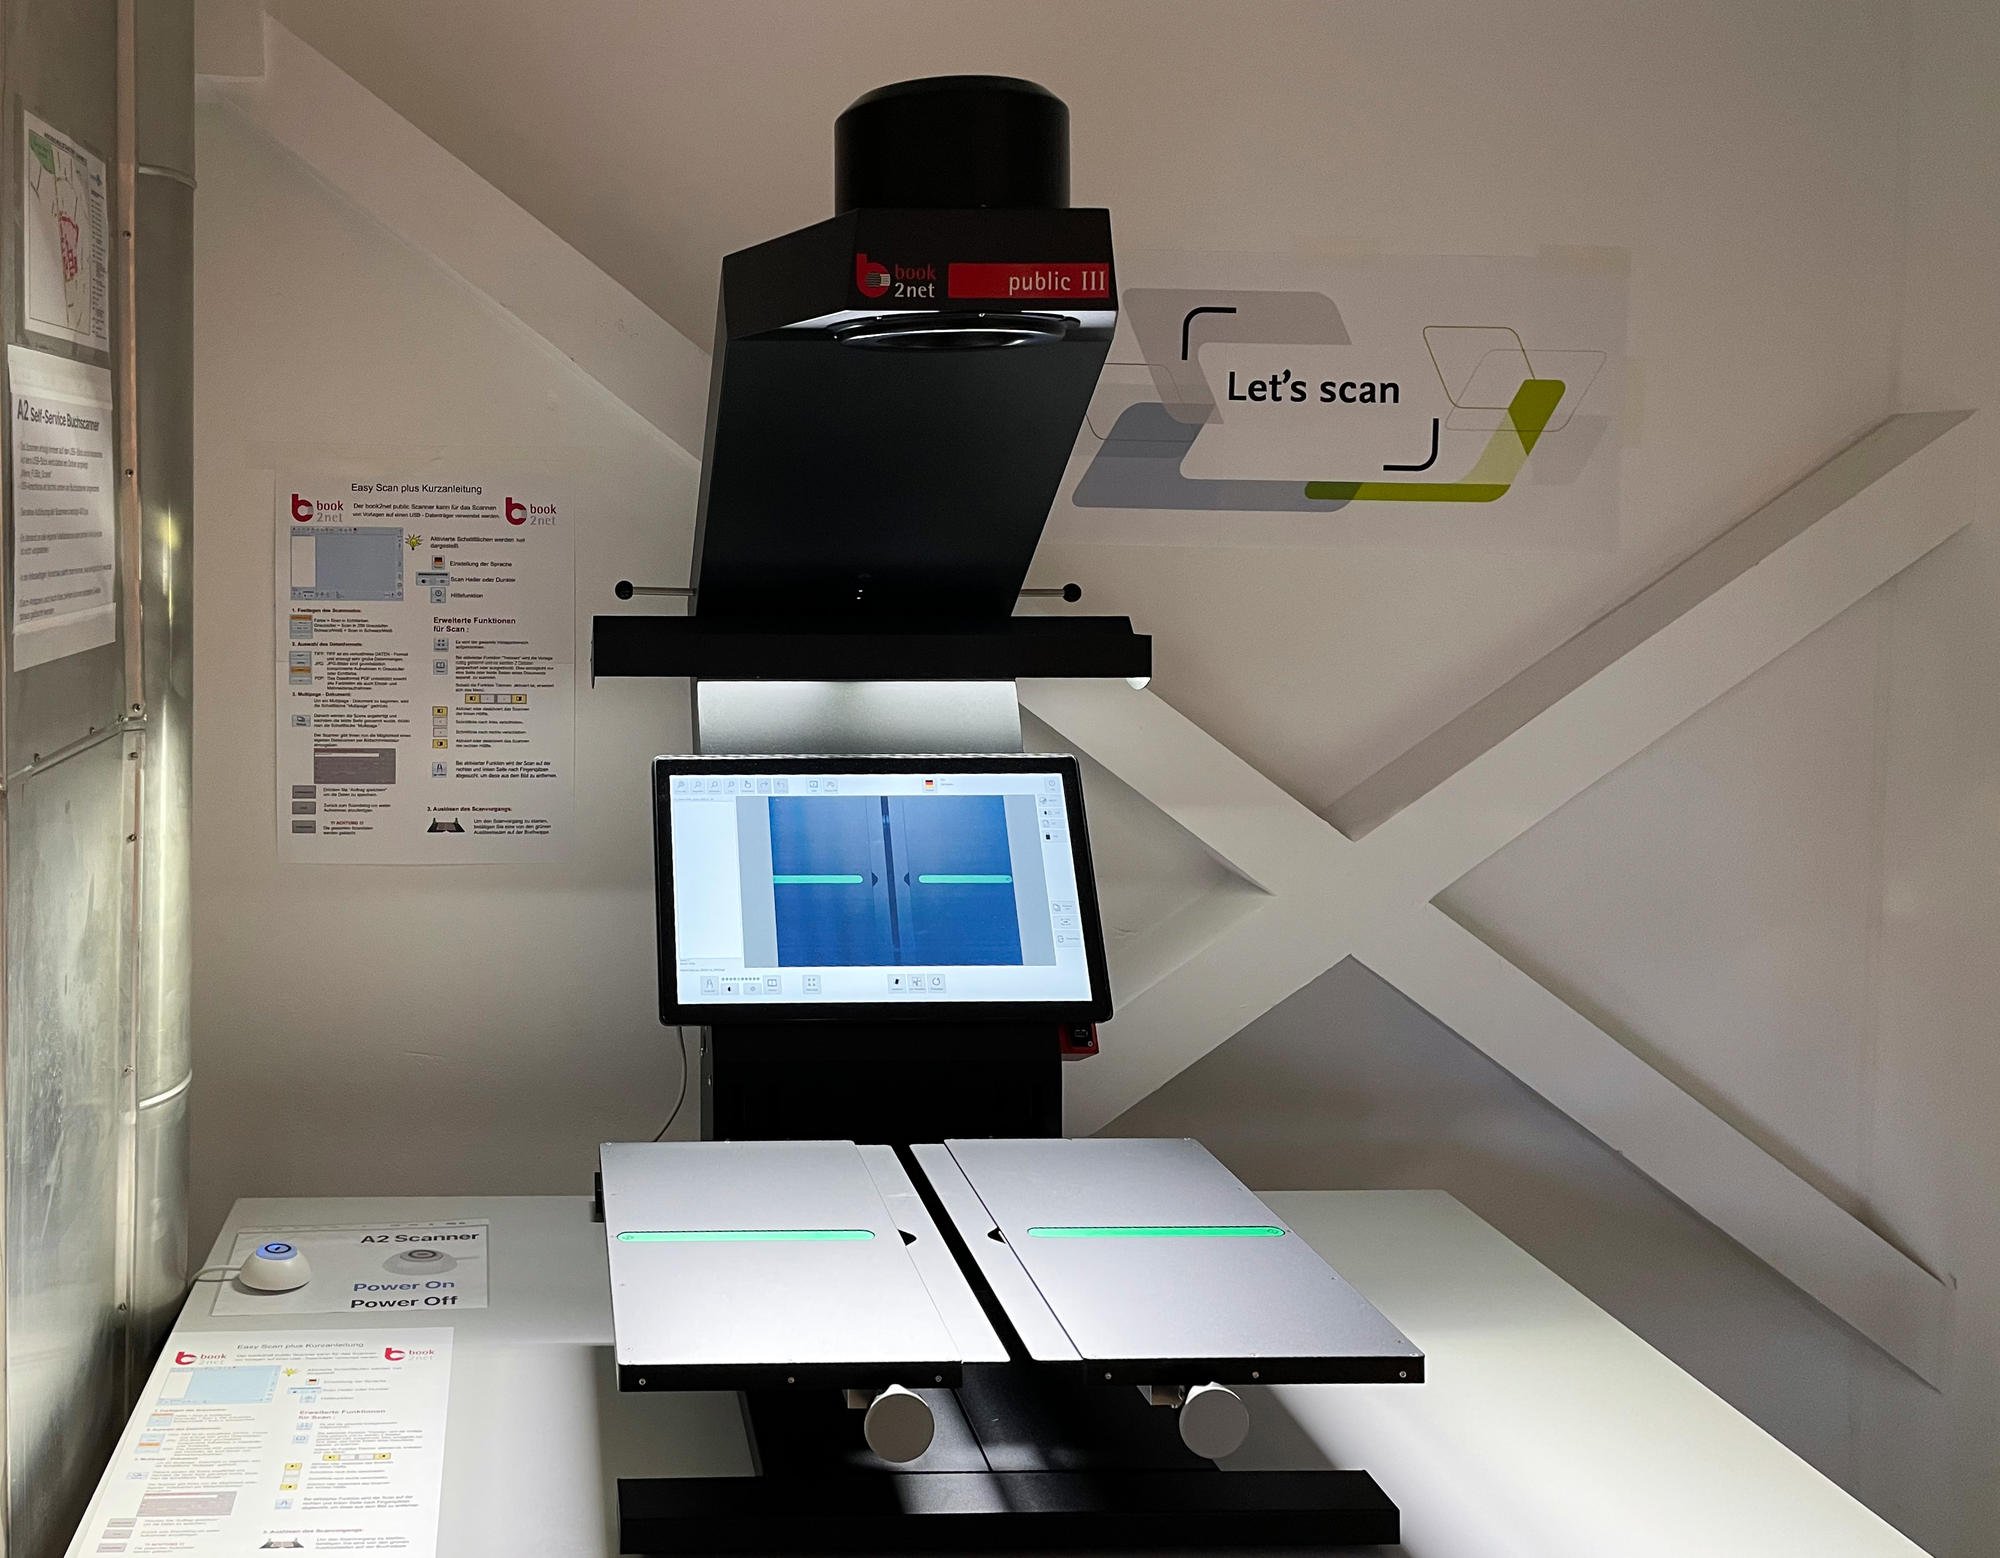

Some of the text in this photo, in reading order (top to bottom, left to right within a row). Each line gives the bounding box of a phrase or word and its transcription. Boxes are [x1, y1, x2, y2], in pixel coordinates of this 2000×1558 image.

[895, 263, 936, 280] book
[1009, 270, 1106, 296] public III
[895, 282, 935, 298] 2net
[1228, 369, 1400, 403] Let's scan
[17, 398, 100, 432] A2 Self-Service Buchscanner
[351, 484, 482, 495] Easy Scan plus Kurzanleitung
[316, 500, 344, 510] book
[530, 503, 557, 514] book
[316, 512, 343, 522] 2net
[530, 515, 557, 526] 2net
[361, 1233, 479, 1243] A2 Scanner
[353, 1281, 455, 1291] Power On
[351, 1296, 458, 1308] Power Off
